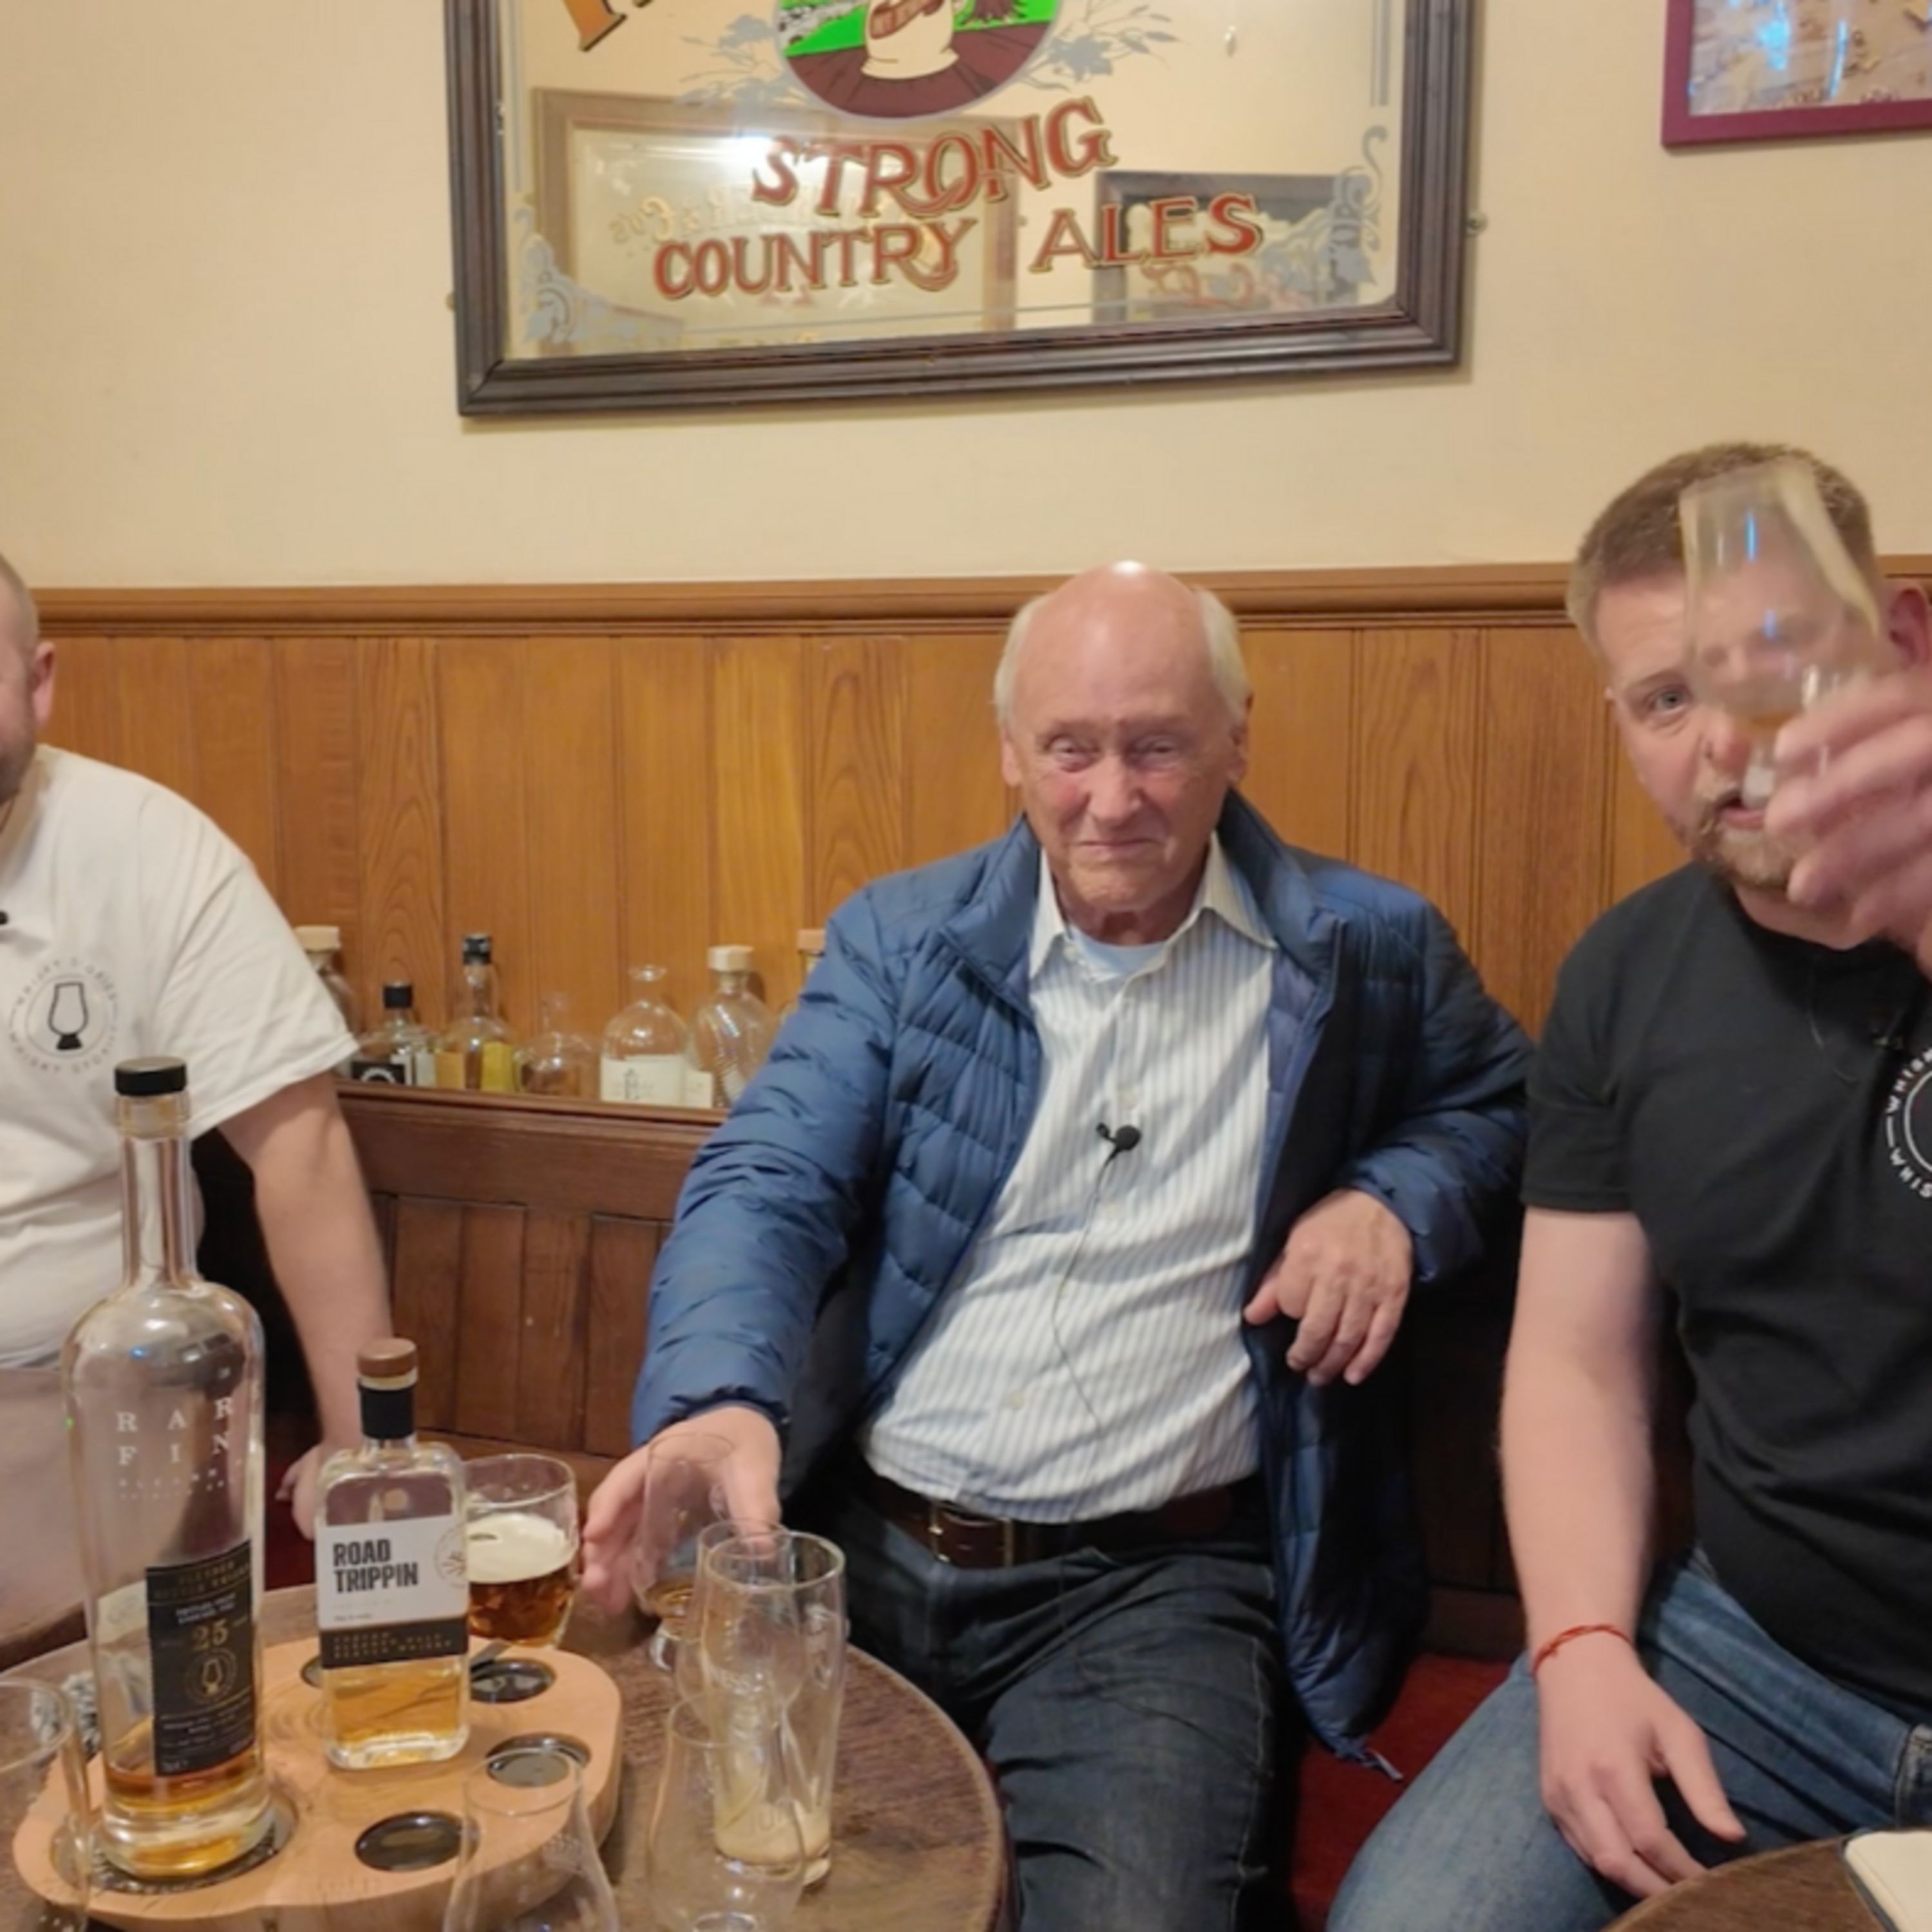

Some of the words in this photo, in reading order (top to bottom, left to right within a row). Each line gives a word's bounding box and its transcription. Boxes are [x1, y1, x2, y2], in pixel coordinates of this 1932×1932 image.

[752, 97, 1118, 218] STRONG
[653, 219, 977, 300] COUNTRY
[1029, 193, 1264, 273] ALES
[116, 1396, 234, 1434] RAR
[117, 1432, 229, 1468] FIN
[332, 1539, 392, 1567] ROAD
[334, 1562, 418, 1594] TRIPPIN
[192, 1618, 229, 1650] 25
